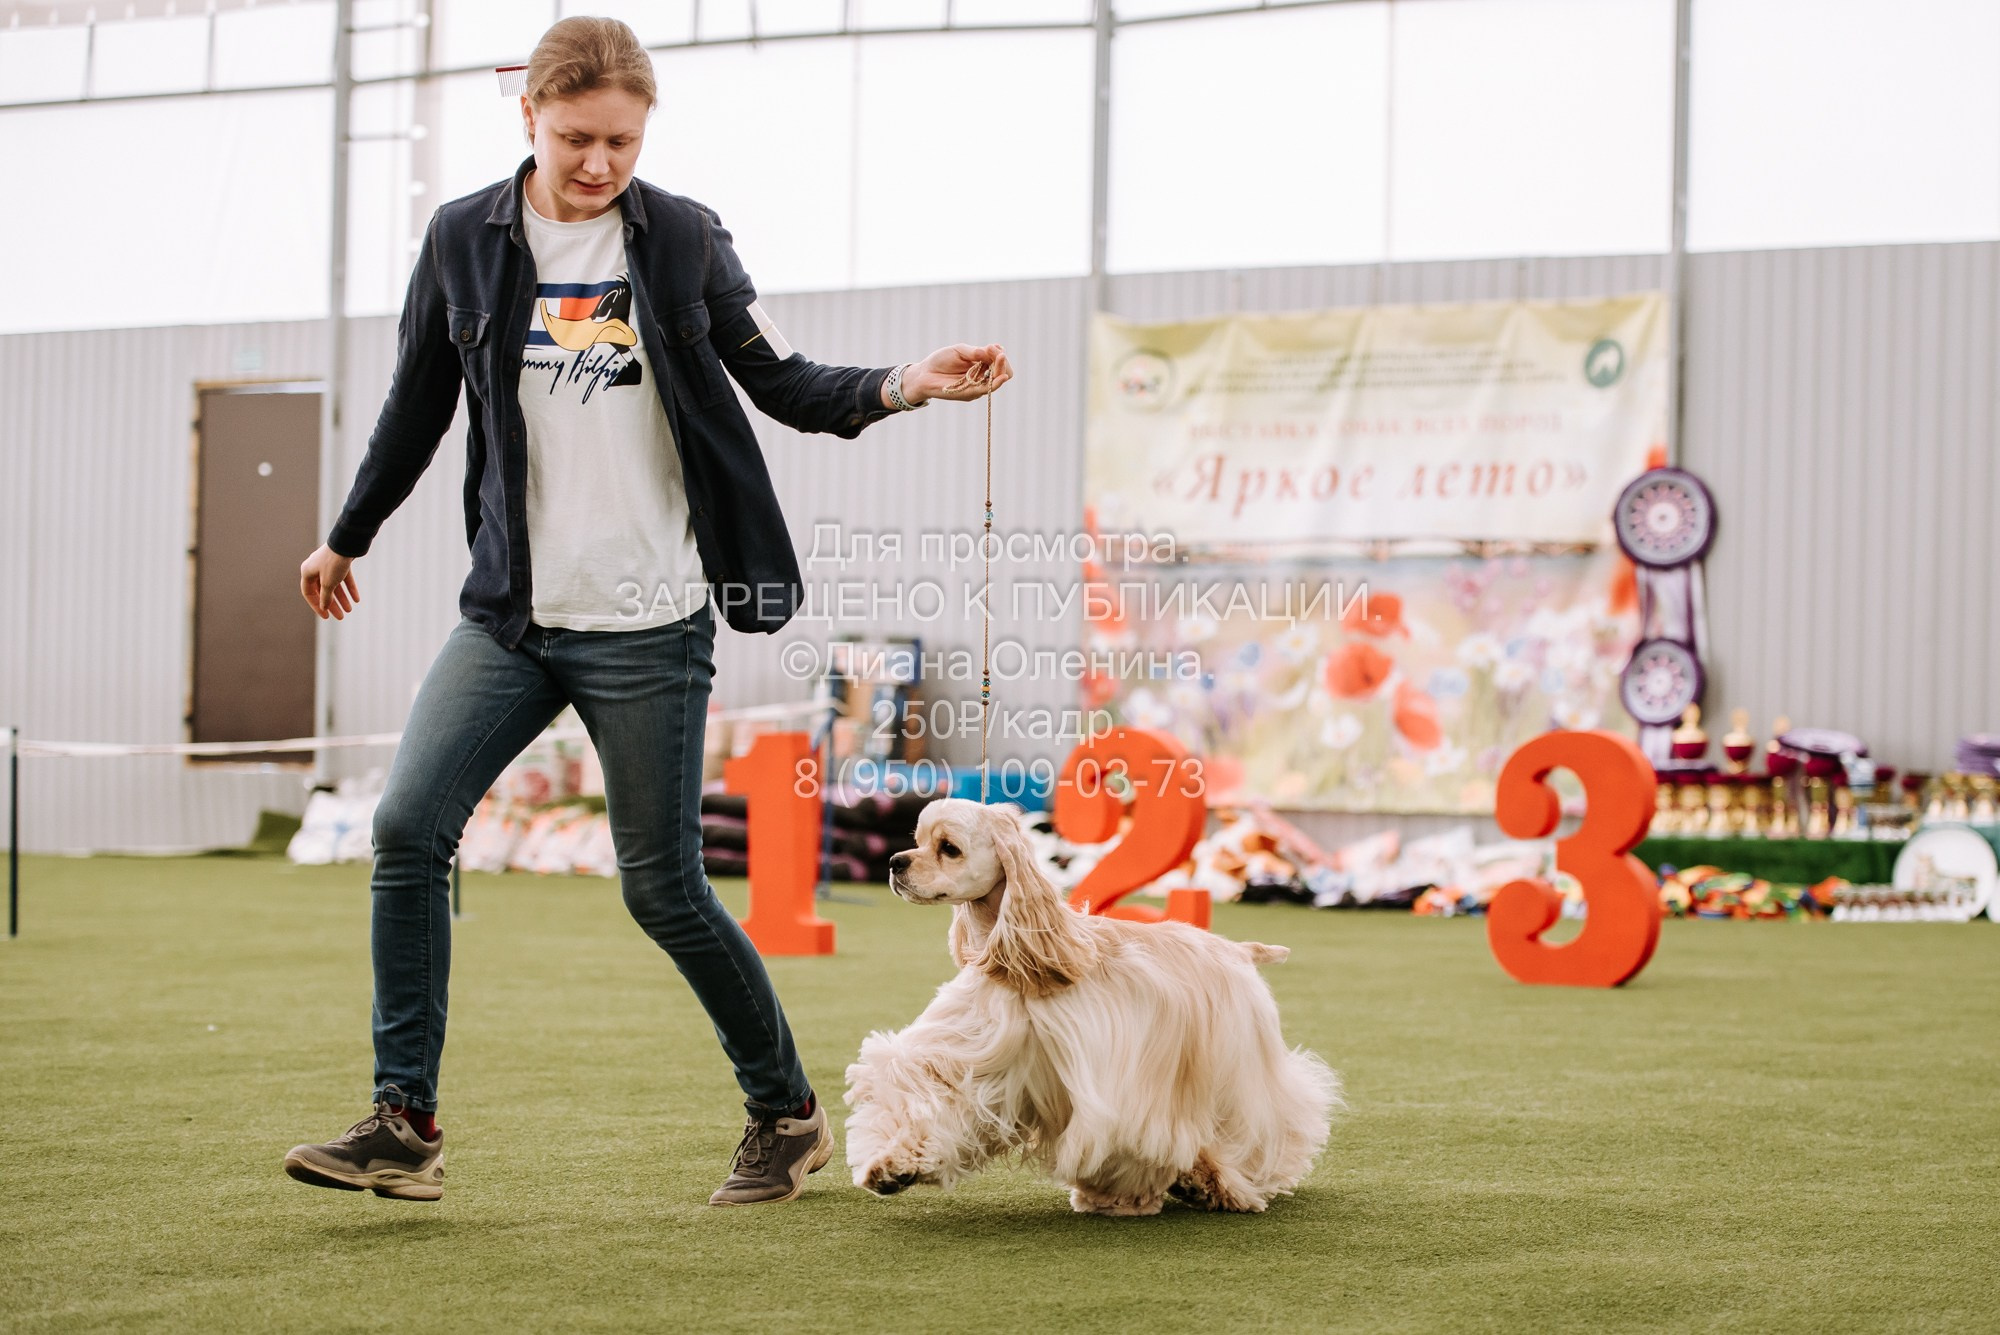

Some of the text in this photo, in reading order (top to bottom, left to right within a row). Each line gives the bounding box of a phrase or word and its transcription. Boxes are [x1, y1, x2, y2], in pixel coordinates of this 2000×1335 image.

[564, 345, 628, 405] Hilfig
[1152, 453, 1589, 518] «Яркое лето»
[724, 732, 835, 956] 1
[1053, 727, 1212, 932] 2
[1487, 729, 1662, 987] 3
